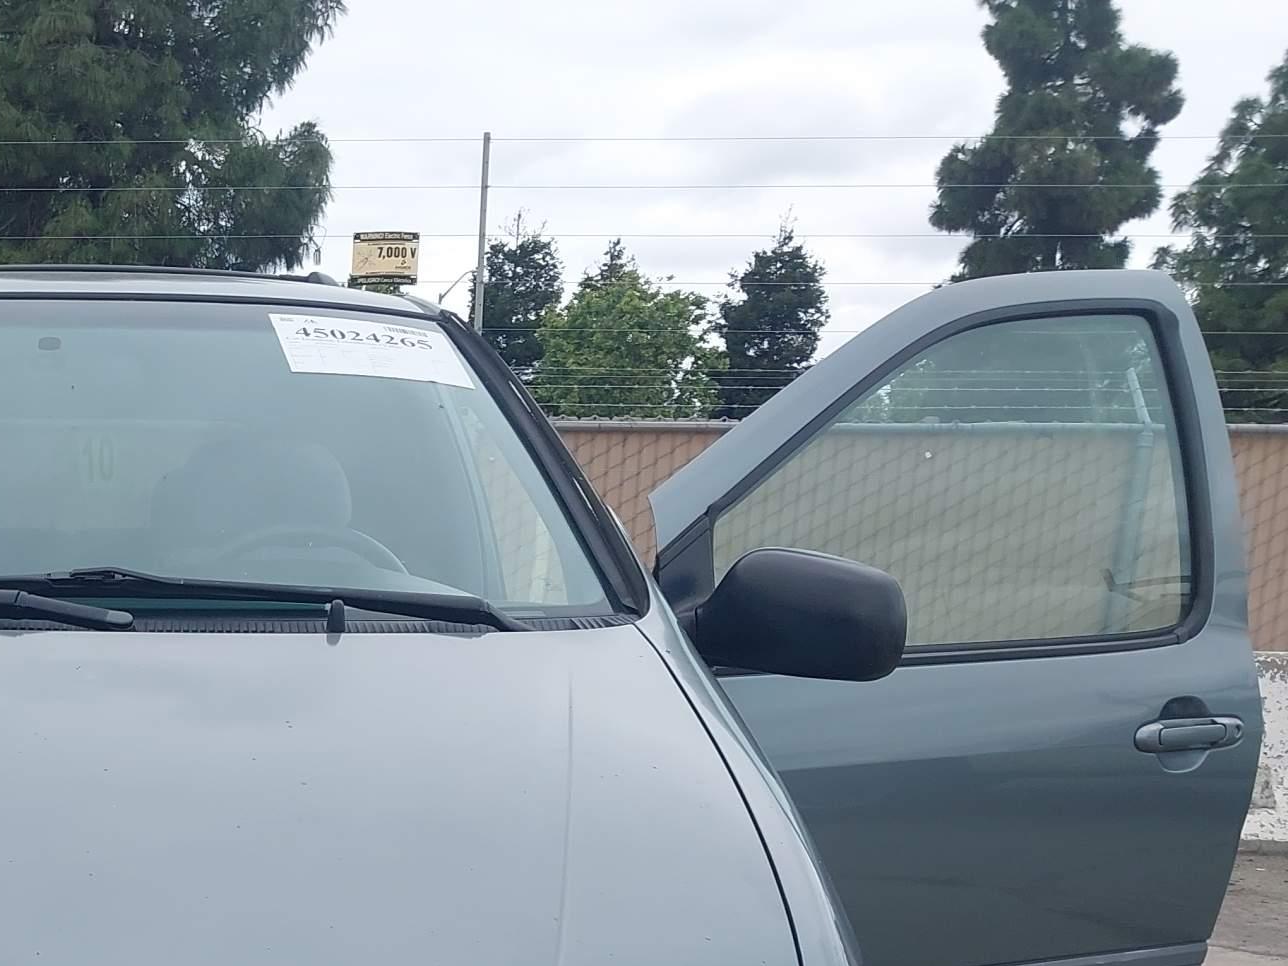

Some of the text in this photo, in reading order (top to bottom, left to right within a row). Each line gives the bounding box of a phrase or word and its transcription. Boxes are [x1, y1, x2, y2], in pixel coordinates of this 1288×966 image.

[377, 246, 417, 260] 7,000 V
[295, 326, 433, 350] 45024265
